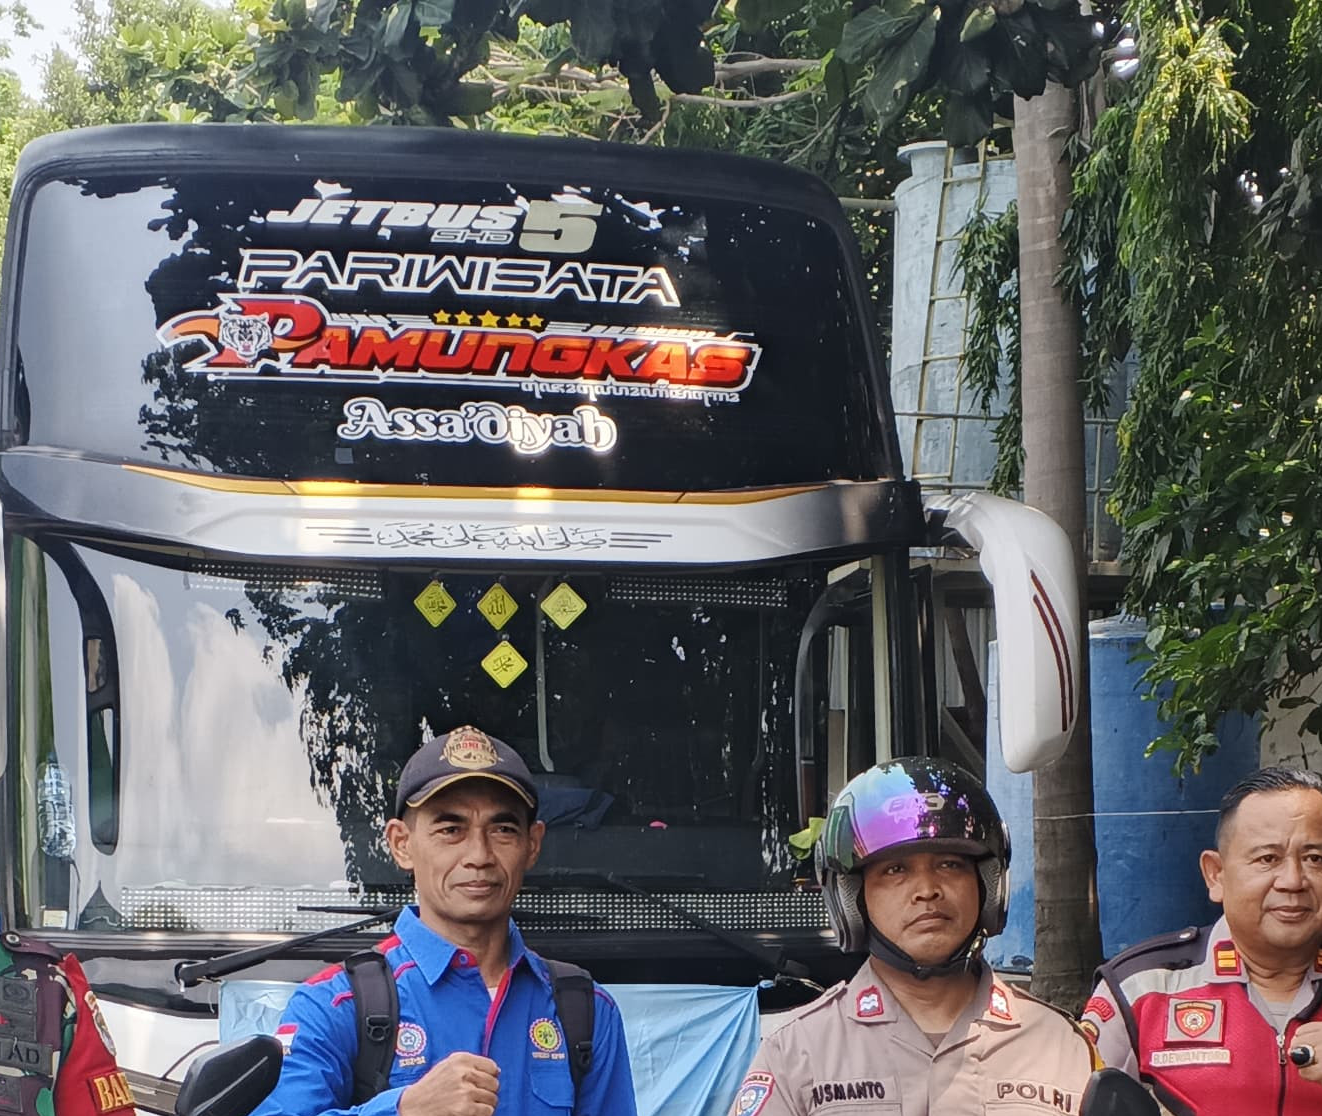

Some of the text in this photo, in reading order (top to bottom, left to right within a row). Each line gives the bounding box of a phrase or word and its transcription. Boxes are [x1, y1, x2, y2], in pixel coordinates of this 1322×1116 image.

[266, 198, 604, 254] JETBUS 5
[430, 227, 515, 245] SHD
[238, 248, 681, 307] PARIWISATA
[189, 295, 760, 390] PAMUNGKAS
[12, 1043, 41, 1066] AD
[996, 1082, 1072, 1113] POLRI
